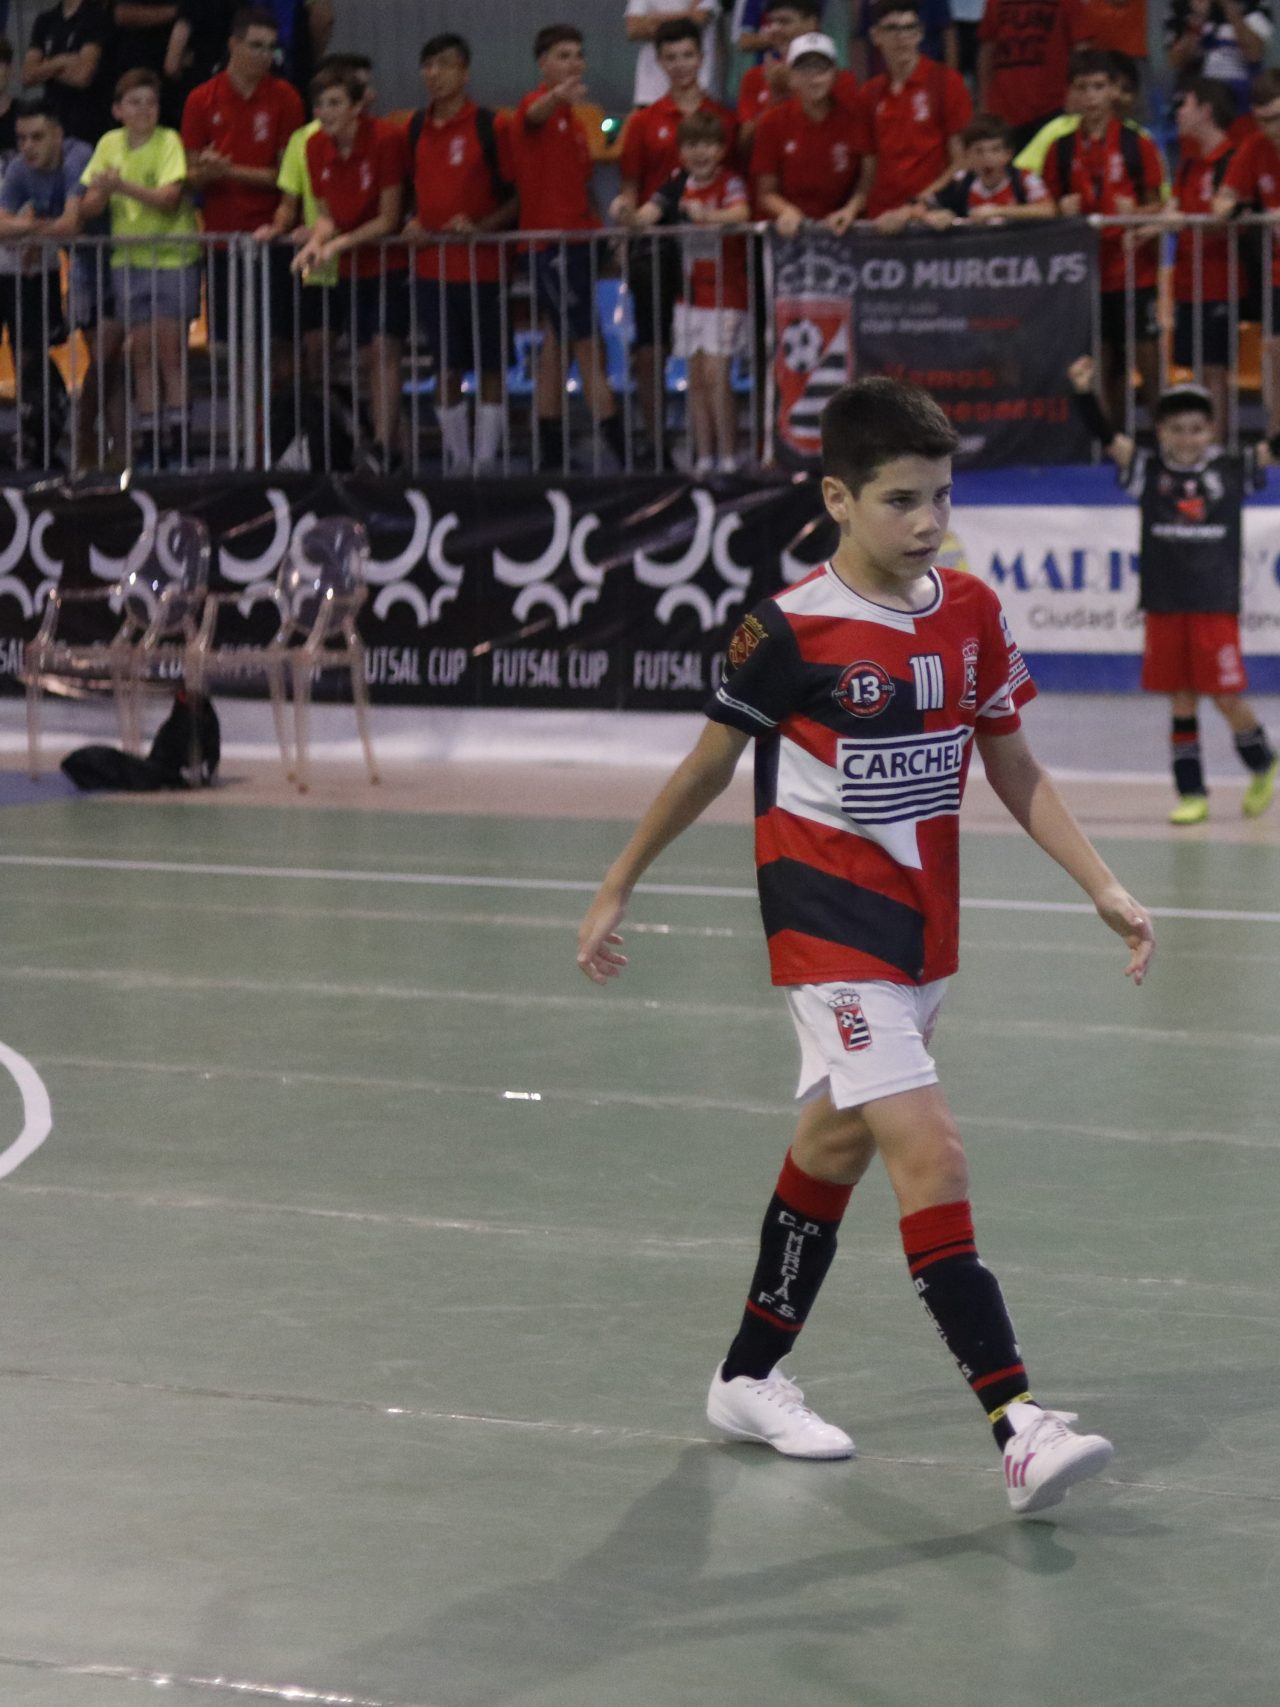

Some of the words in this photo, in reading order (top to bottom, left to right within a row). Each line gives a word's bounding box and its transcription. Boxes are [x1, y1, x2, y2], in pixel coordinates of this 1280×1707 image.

[861, 259, 906, 288] CD
[914, 256, 1042, 288] MURCIA
[1050, 252, 1088, 284] FS
[990, 549, 1140, 593] MARI
[364, 647, 420, 685] UTSAL
[428, 647, 467, 685] CUP
[492, 648, 562, 688] FUTSAL
[568, 650, 610, 688] CUP
[633, 650, 706, 691] FUTSAL
[851, 675, 882, 704] 13
[843, 743, 961, 780] CARCHEL
